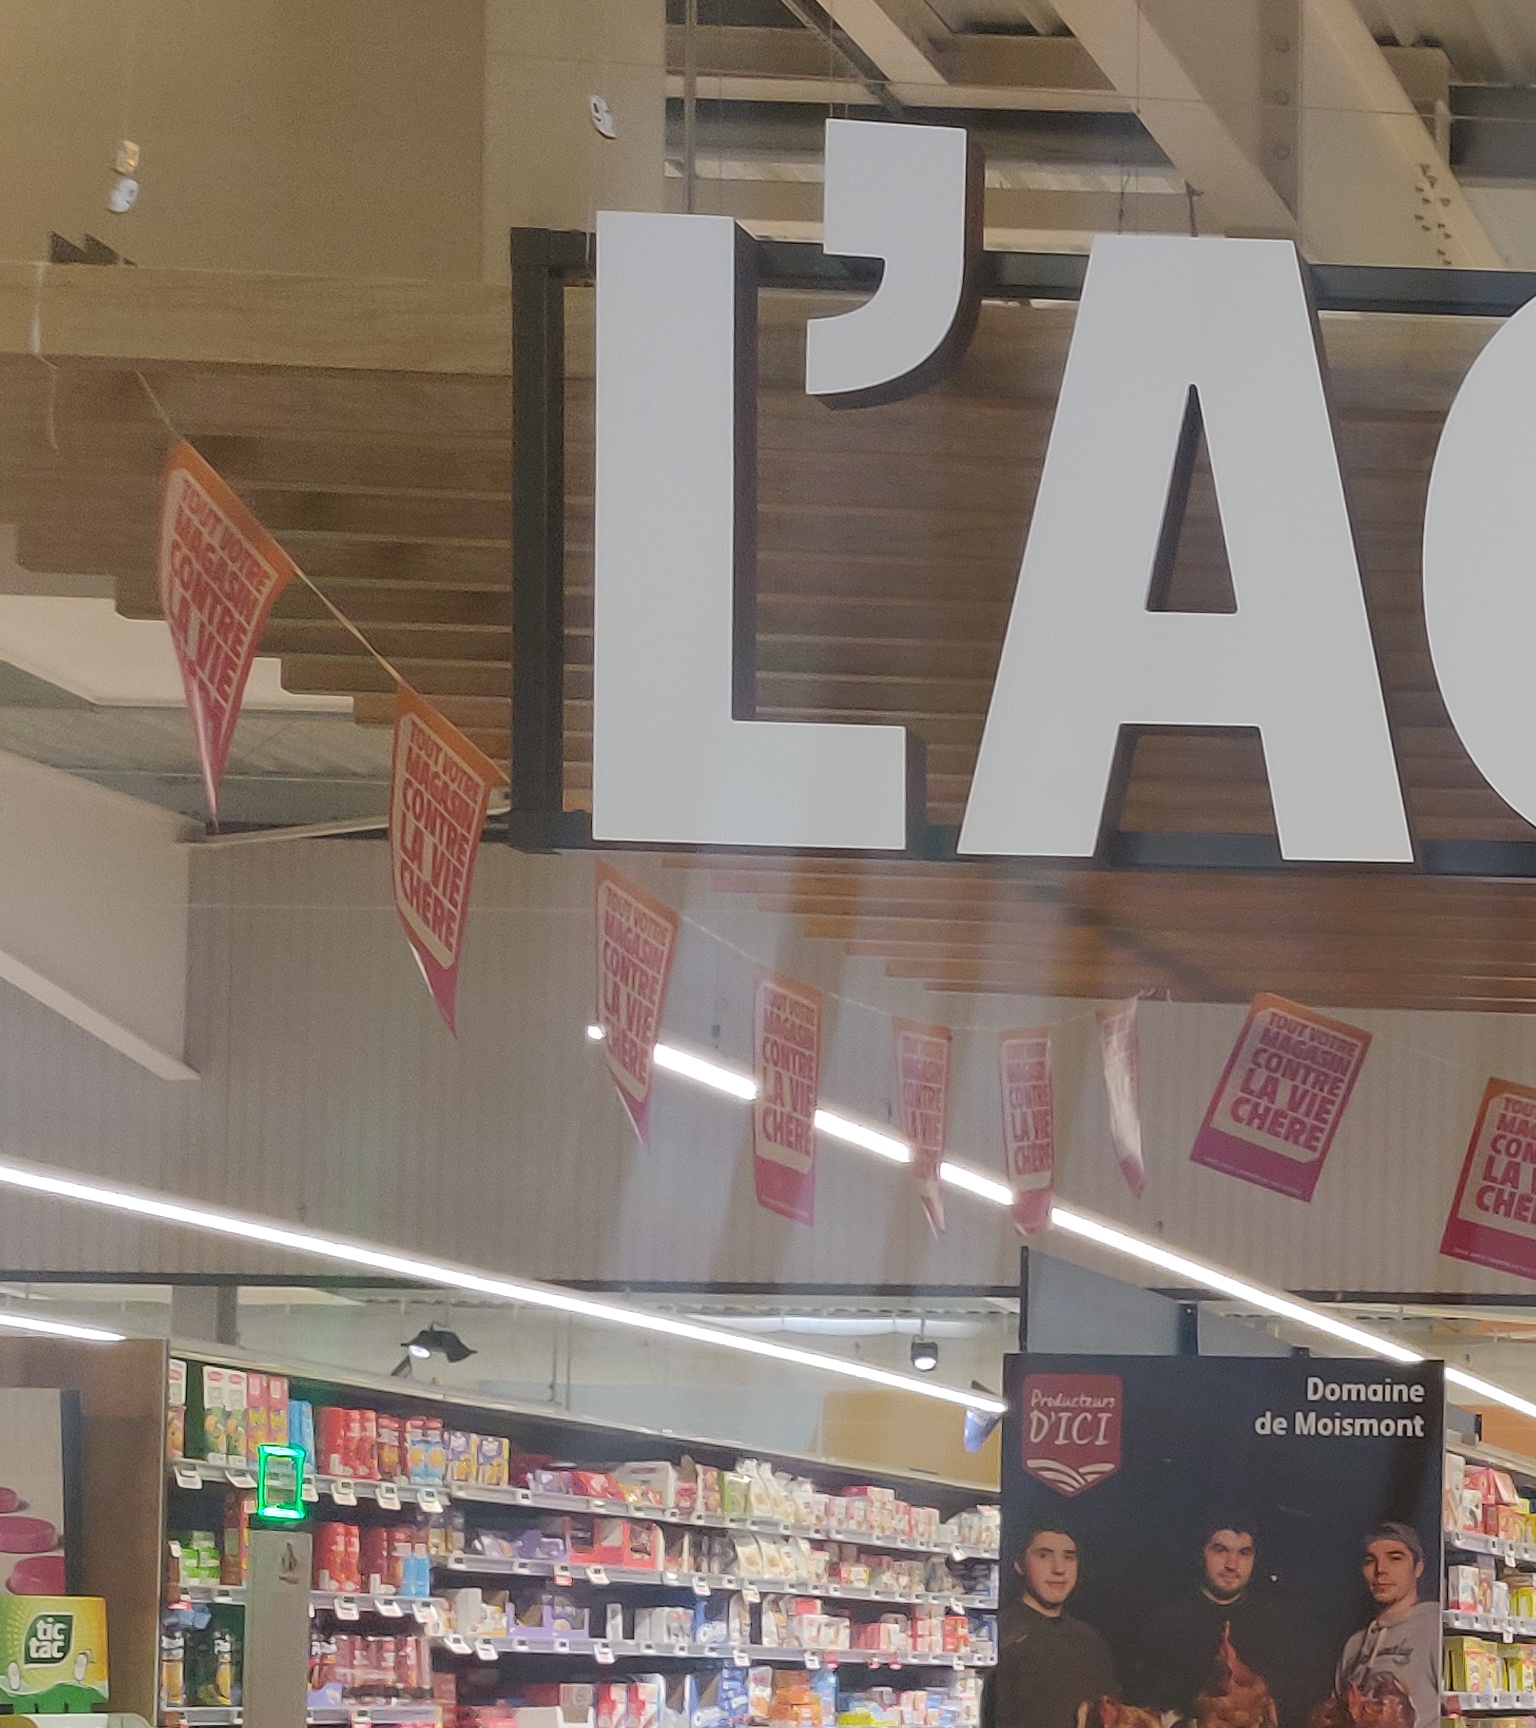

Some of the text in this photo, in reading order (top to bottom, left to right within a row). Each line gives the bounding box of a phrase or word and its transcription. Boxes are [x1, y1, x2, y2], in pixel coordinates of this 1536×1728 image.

[1031, 1389, 1115, 1409] Producteurs
[1306, 1377, 1425, 1403] Domaine
[1030, 1411, 1113, 1446] D'ICI
[1255, 1411, 1425, 1437] de Moismont
[36, 1618, 64, 1640] tic
[29, 1638, 64, 1658] tac
